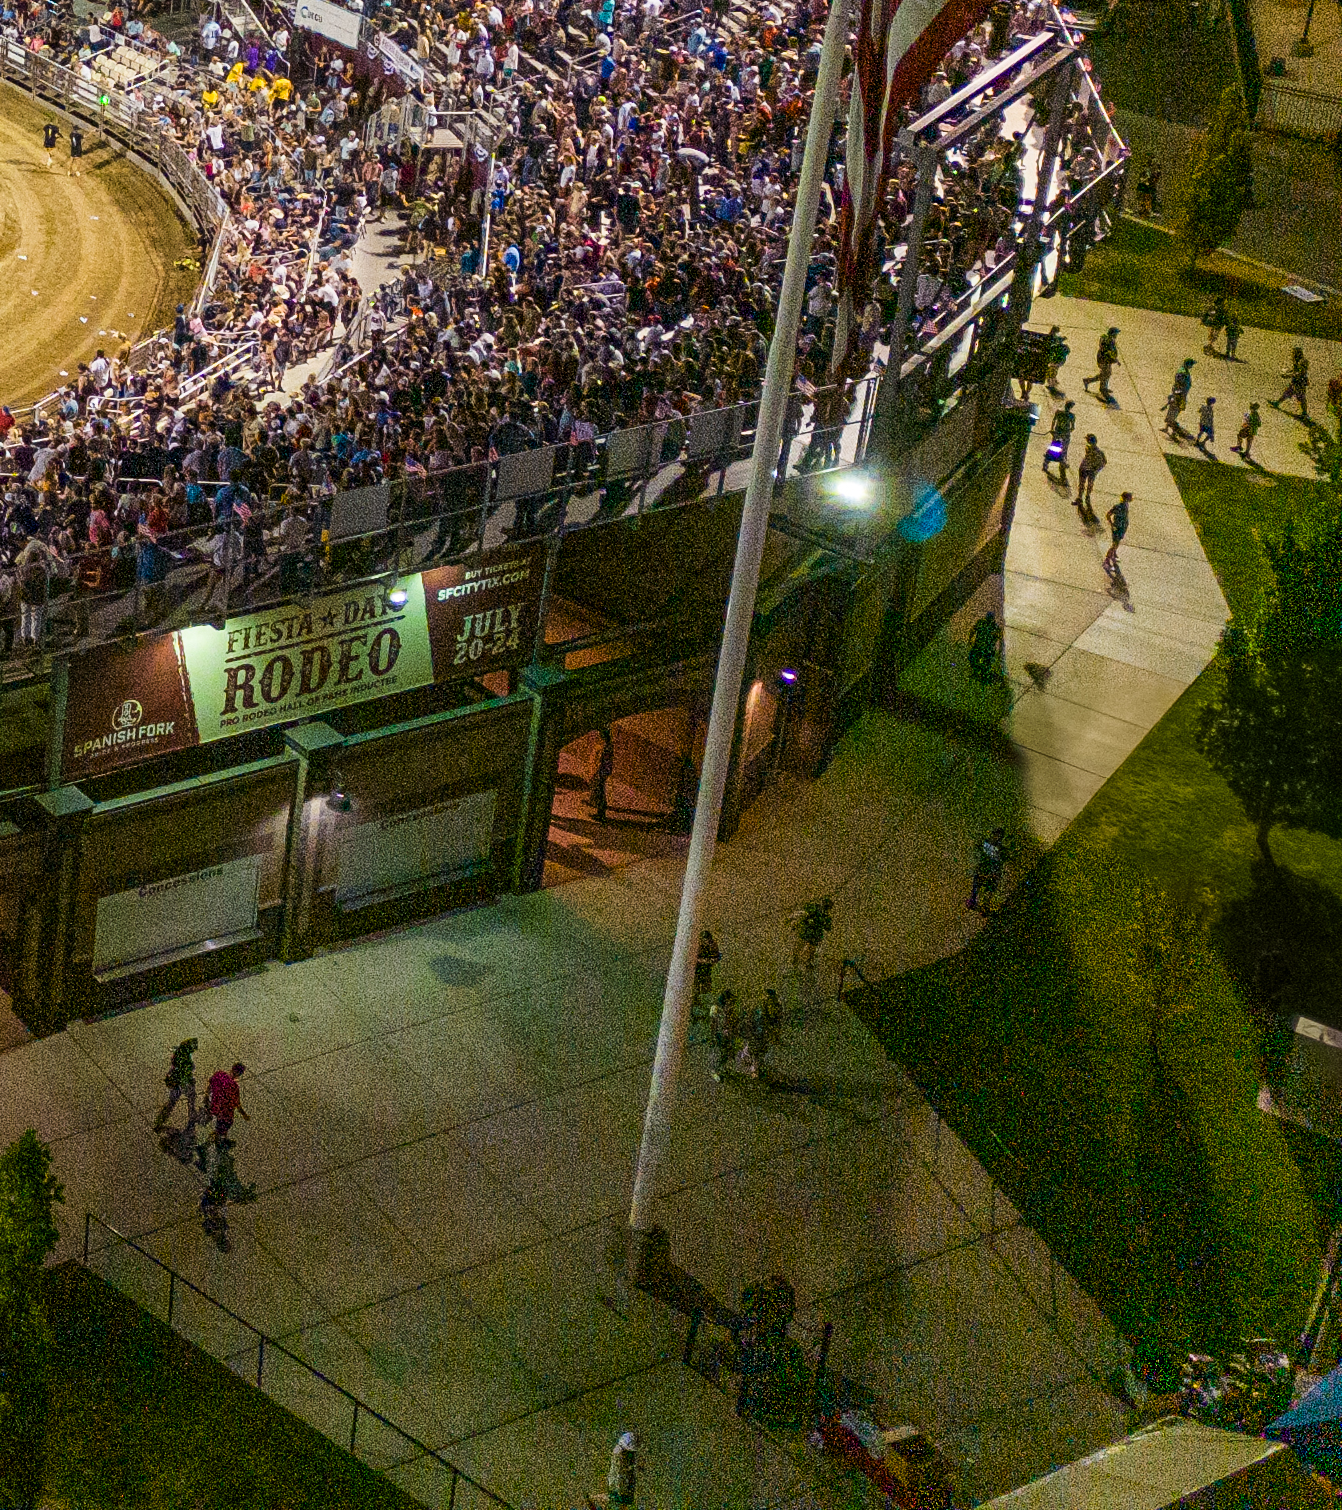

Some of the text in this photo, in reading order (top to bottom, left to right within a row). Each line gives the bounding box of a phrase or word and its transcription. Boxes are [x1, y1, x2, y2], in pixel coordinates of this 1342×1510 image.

[465, 569, 483, 580] BUY
[225, 611, 315, 655] FIESTA
[456, 603, 527, 642] JULY
[453, 630, 519, 666] 20-24
[220, 627, 403, 716] RODEO
[219, 716, 240, 728] PRO
[241, 707, 278, 723] RODEO
[279, 700, 305, 712] HALL
[74, 727, 136, 758] SPANISH
[138, 721, 175, 739] FORK
[138, 866, 223, 898] Concessions
